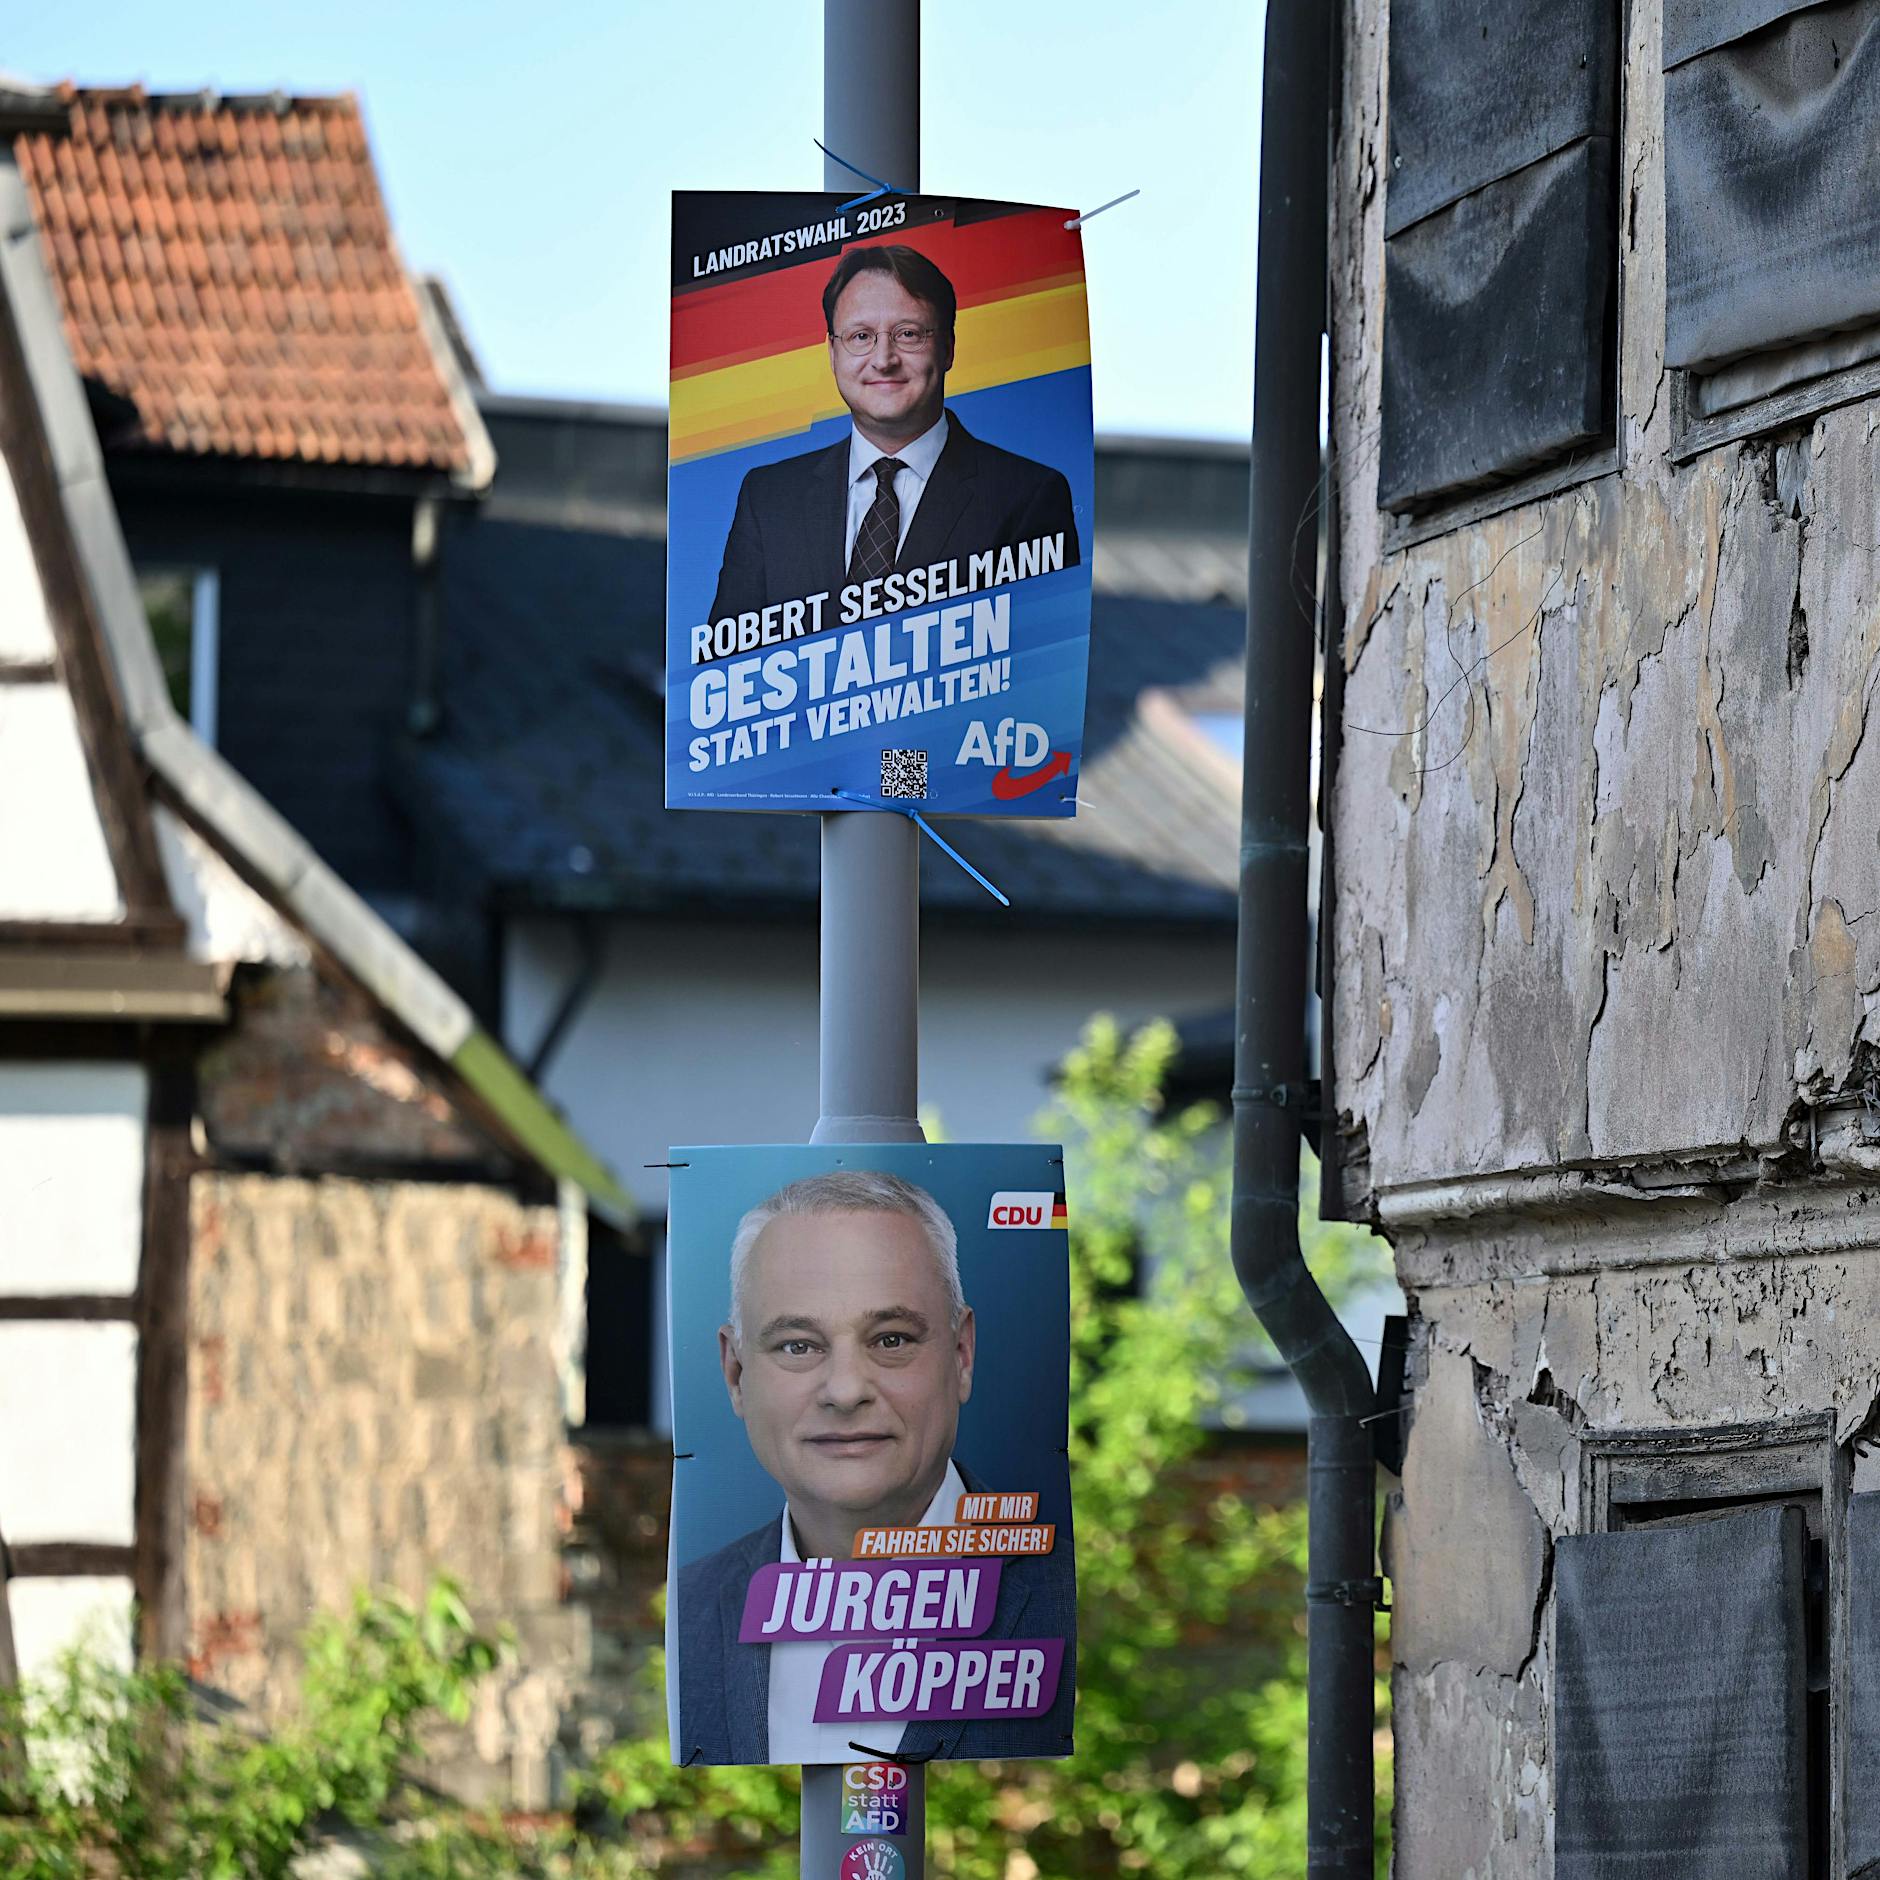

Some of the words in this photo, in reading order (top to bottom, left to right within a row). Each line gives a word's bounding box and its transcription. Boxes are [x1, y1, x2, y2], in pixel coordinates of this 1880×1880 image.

[693, 216, 852, 278] LANDRATSWAHL
[856, 202, 906, 235] 2023
[690, 592, 829, 665] ROBERT
[839, 532, 1065, 624] SESSELMANN
[689, 592, 1011, 729] GESTALTEN
[688, 713, 797, 773] STATT
[806, 657, 1011, 741] VERWALTEN!
[954, 717, 1050, 767] AfD
[993, 1206, 1042, 1226] CDU
[962, 1495, 998, 1520] MIT
[998, 1495, 1033, 1519] MIR
[860, 1529, 943, 1555] FAHREN
[945, 1529, 977, 1553] SIE
[978, 1528, 1049, 1553] SICHER!
[761, 1557, 980, 1634] JÜRGEN
[837, 1637, 1045, 1714] KÖPPER
[845, 1766, 907, 1790] CSD
[848, 1793, 899, 1808] statt
[845, 1810, 899, 1831] AFD
[849, 1842, 875, 1861] KEIN
[878, 1843, 898, 1859] ORT
